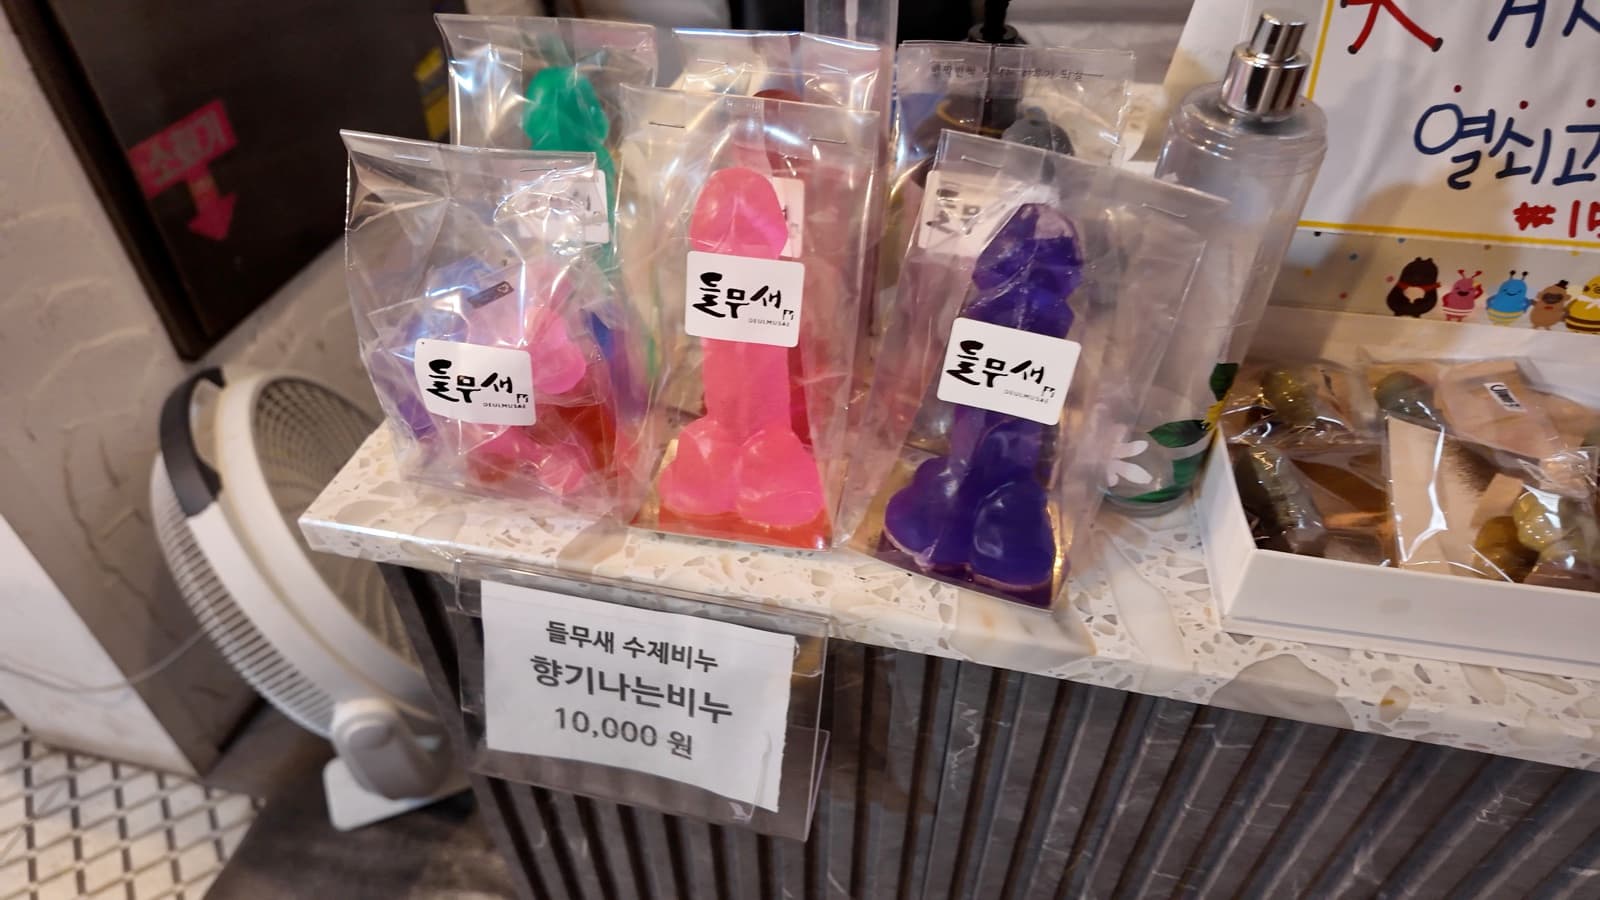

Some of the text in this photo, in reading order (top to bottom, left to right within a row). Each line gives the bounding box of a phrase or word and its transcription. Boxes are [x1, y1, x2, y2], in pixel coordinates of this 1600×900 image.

[692, 272, 782, 319] 들무새
[426, 358, 513, 404] 들무새
[946, 339, 1045, 388] 들무새
[545, 620, 719, 674] 들무새 수제비누
[529, 655, 733, 724] 향기나는비누
[554, 707, 693, 761] 10,000 원
